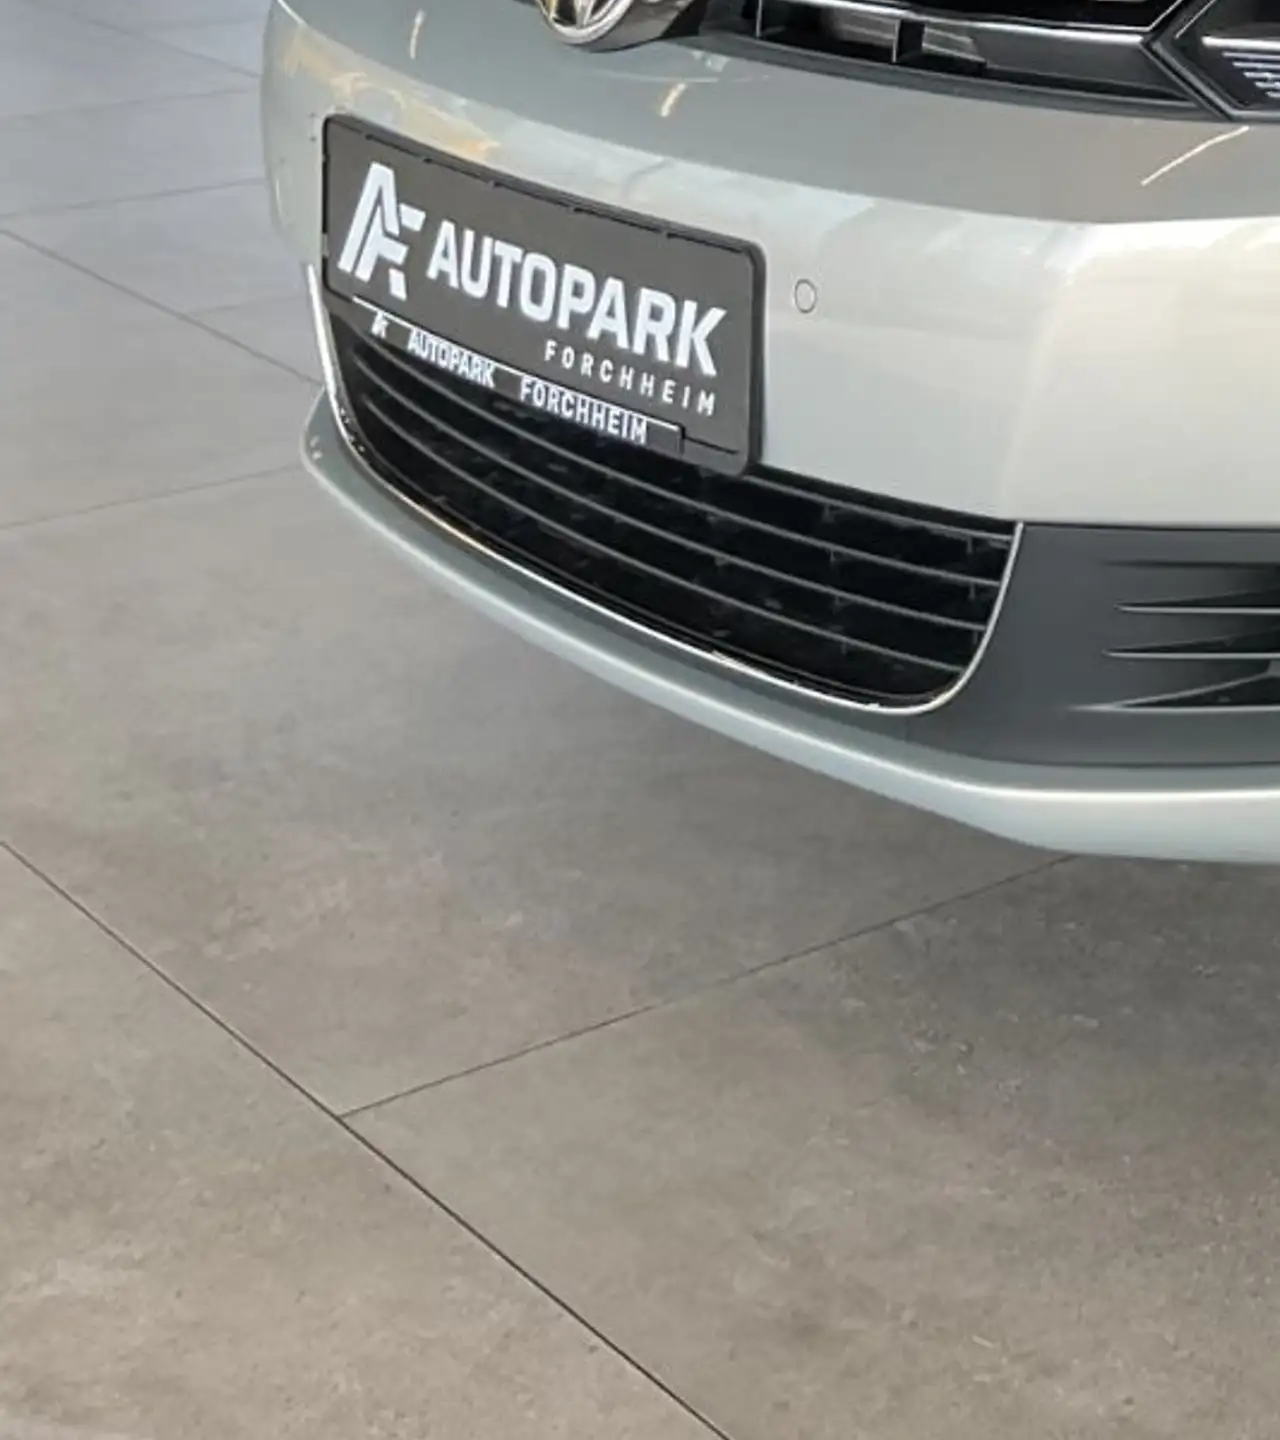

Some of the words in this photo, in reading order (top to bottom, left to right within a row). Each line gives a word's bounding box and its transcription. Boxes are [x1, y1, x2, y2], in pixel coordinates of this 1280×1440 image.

[427, 220, 727, 376] AUTOPARK
[407, 327, 497, 389] AUTOPARK
[519, 374, 648, 446] FORCHHEIM
[544, 339, 716, 417] FORCHHEIM
